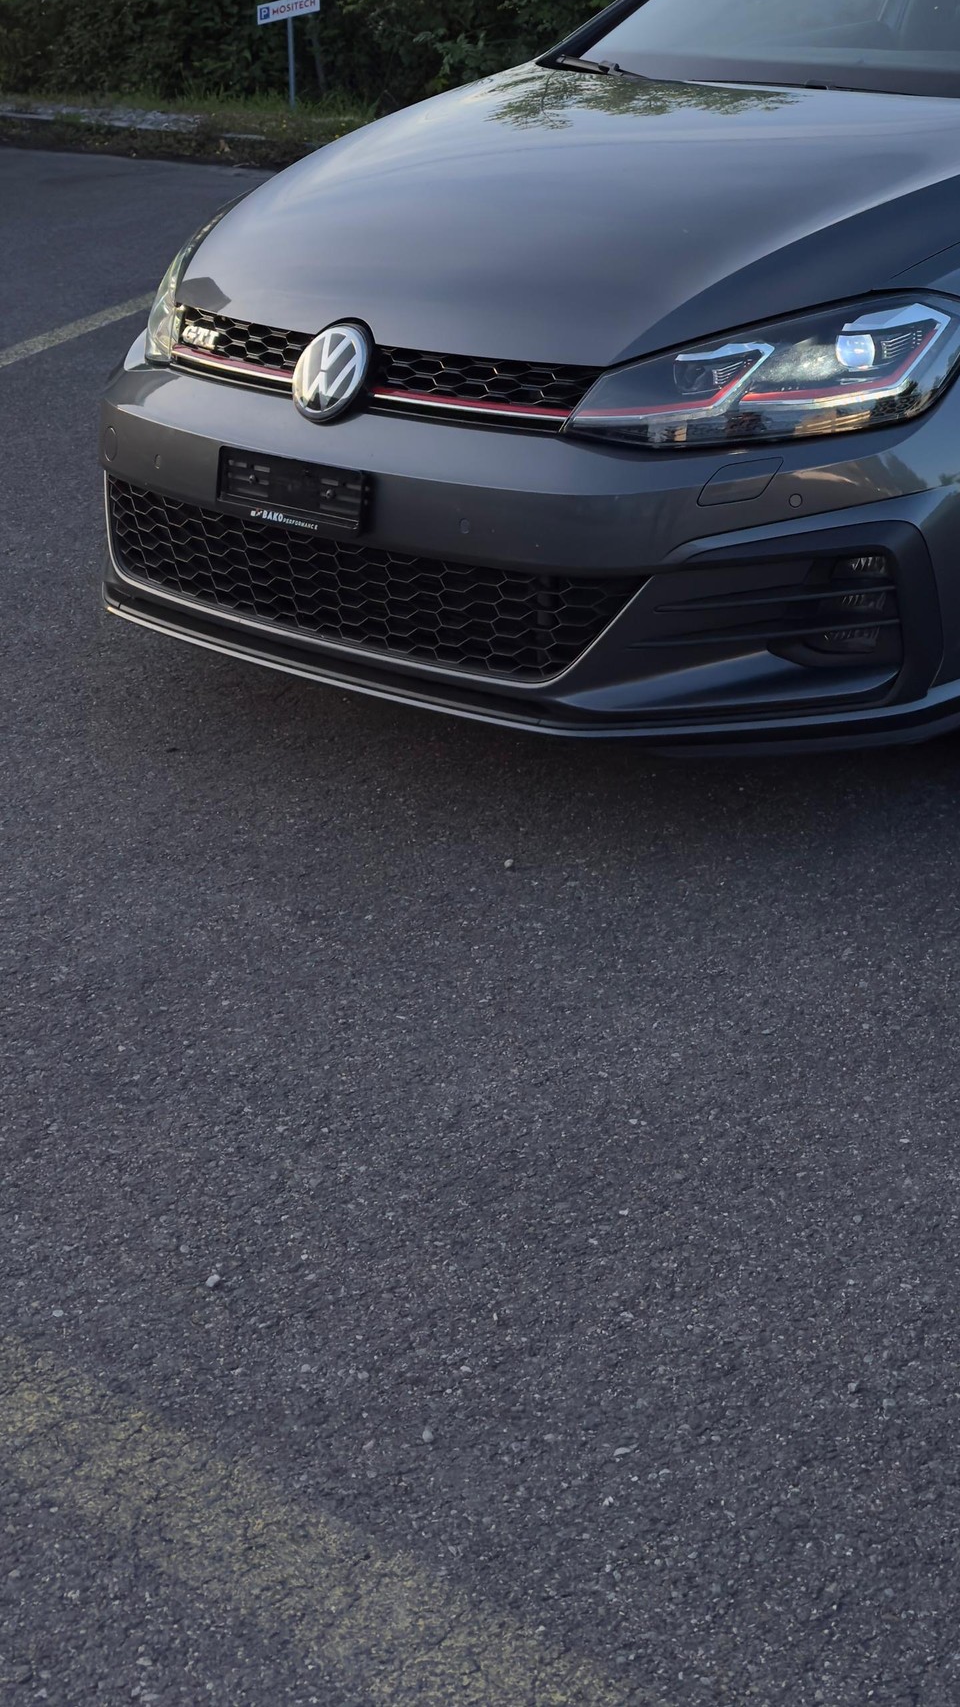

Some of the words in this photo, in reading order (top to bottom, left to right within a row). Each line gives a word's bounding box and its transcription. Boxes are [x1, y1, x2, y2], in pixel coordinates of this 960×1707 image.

[182, 325, 219, 350] GTI
[299, 328, 361, 412] VW
[262, 510, 284, 523] BAKO
[283, 517, 319, 531] PERFORMANCE
